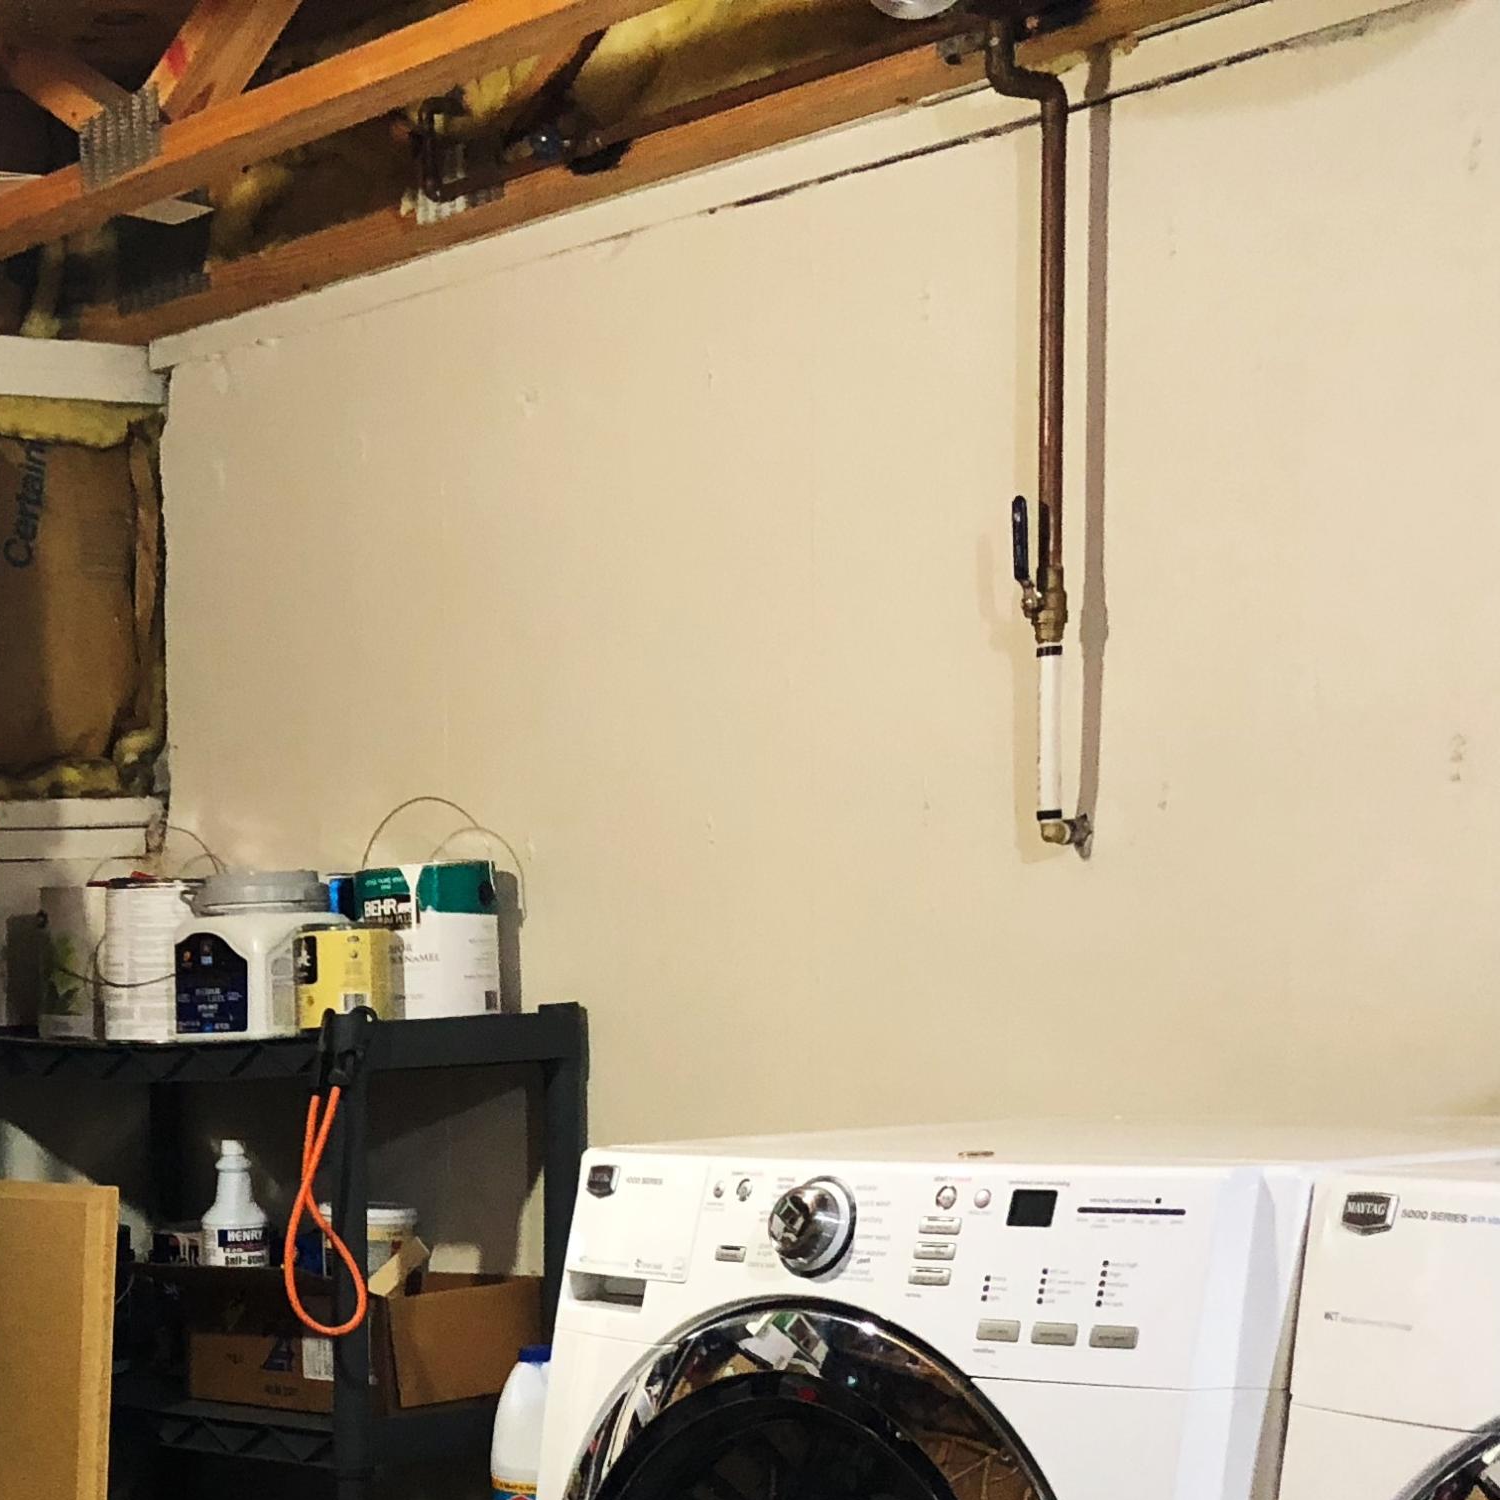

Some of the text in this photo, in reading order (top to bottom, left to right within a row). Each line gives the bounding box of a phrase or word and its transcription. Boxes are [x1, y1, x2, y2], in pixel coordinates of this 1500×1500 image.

[364, 898, 398, 917] BEHR
[1347, 1201, 1386, 1216] MAYTAG
[1430, 1211, 1468, 1223] SERIES
[227, 1230, 264, 1242] HENRY
